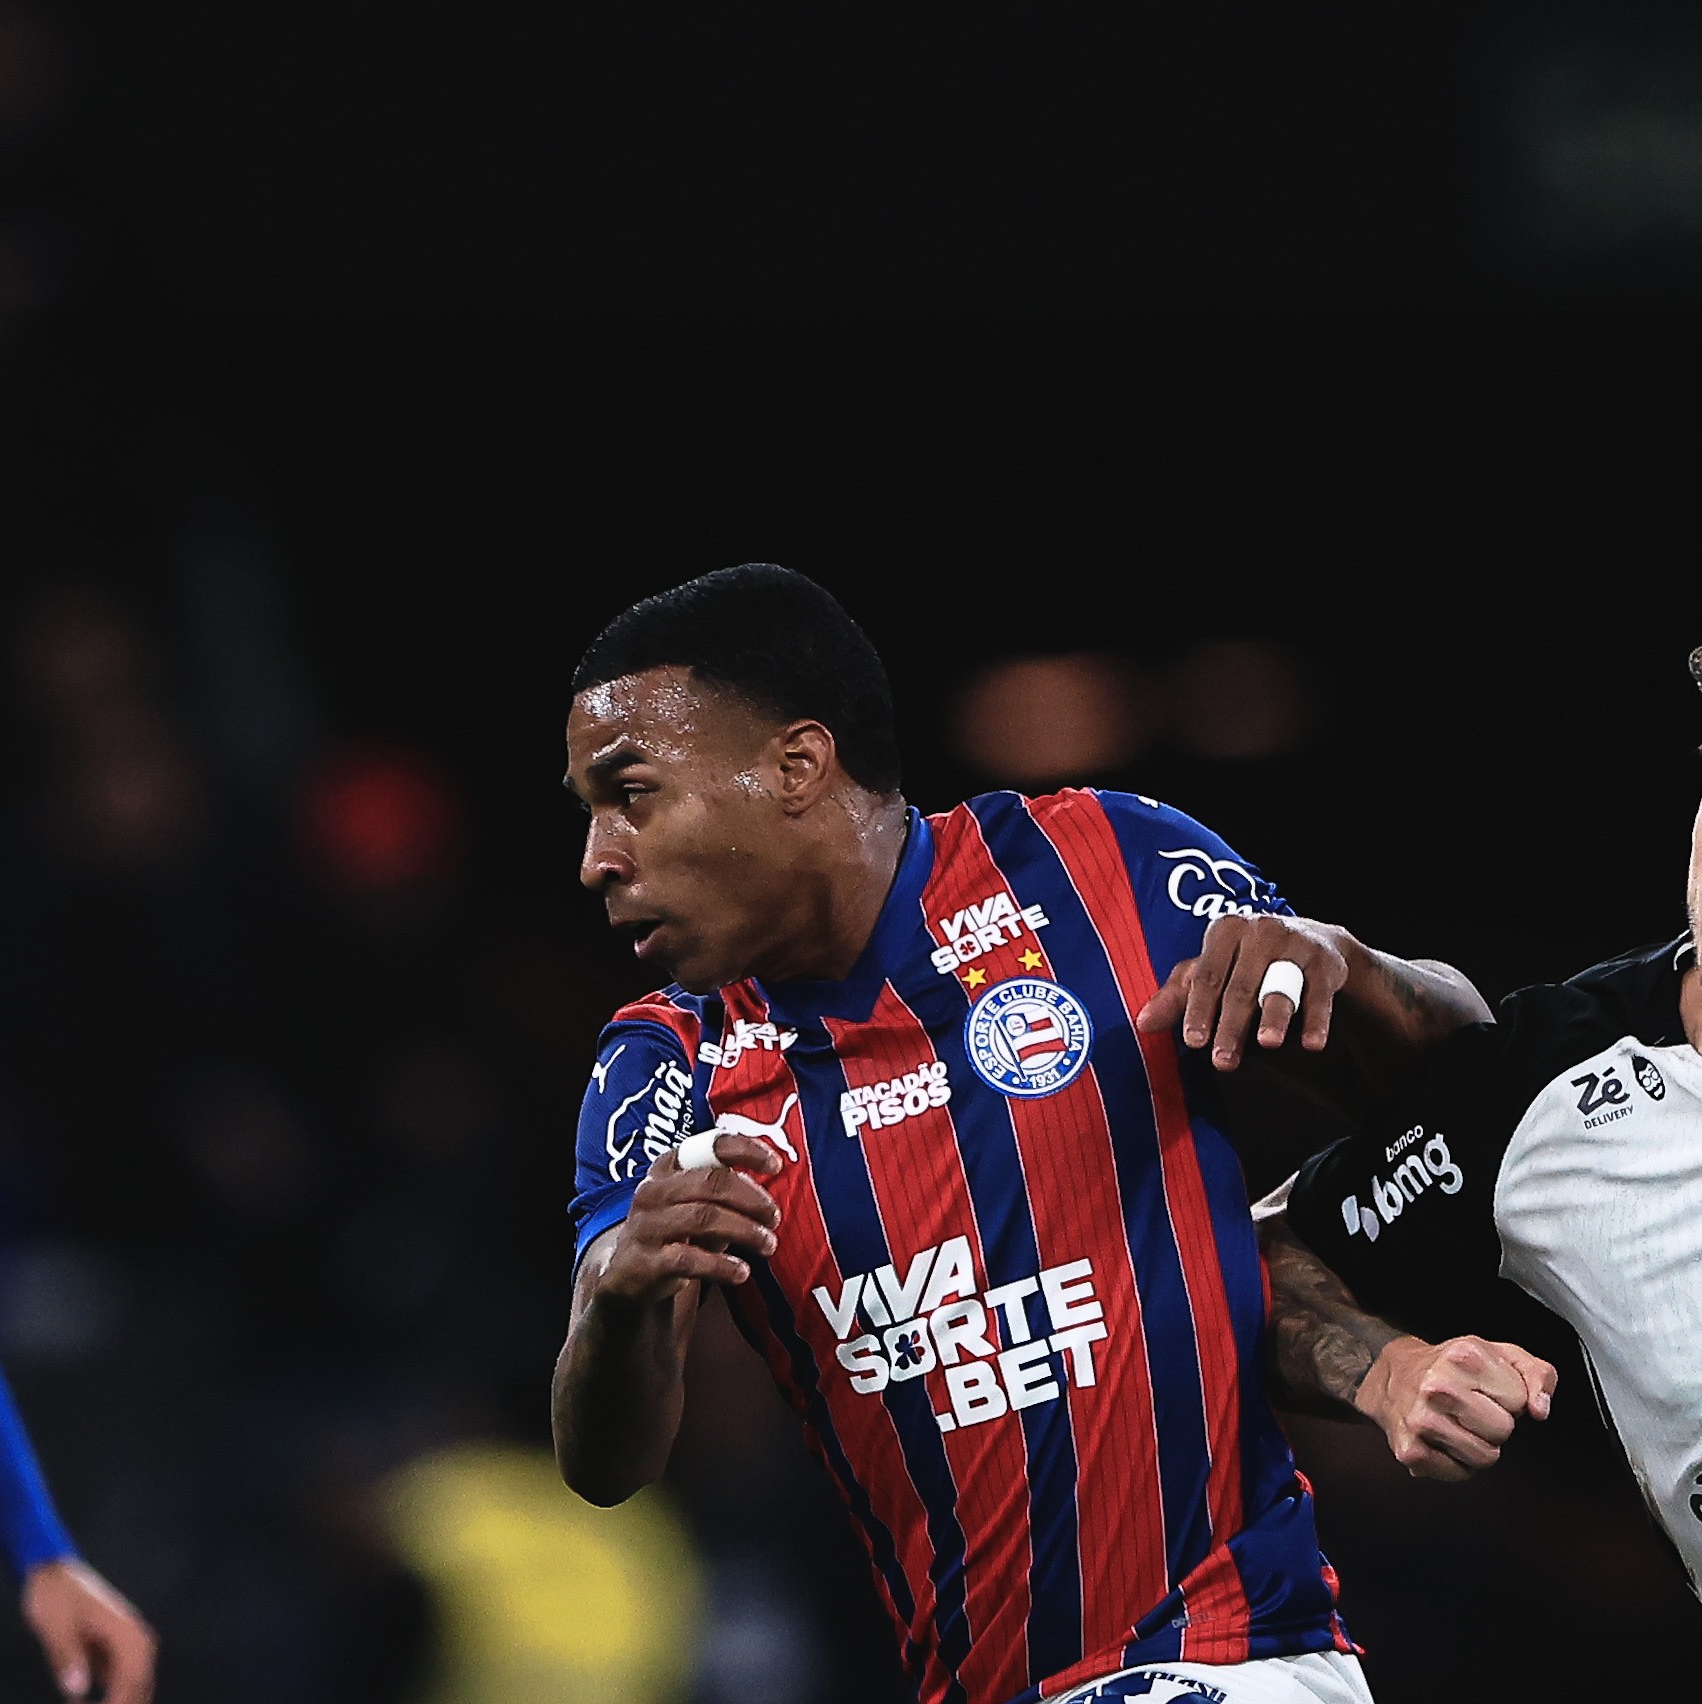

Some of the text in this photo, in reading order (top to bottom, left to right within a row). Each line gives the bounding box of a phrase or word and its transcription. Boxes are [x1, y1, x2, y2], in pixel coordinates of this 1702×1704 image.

[930, 903, 1050, 975] SORTE
[939, 891, 1016, 943] VIVA
[976, 985, 1085, 1080] ESPORTE CLUBE BAHIA
[840, 1061, 947, 1112] ATACADÃO
[841, 1077, 952, 1138] PISOS
[1028, 1068, 1062, 1089] 1931
[1570, 1066, 1631, 1117] Zé
[1385, 1125, 1424, 1163] banco
[1583, 1105, 1634, 1130] DELIVERY
[1371, 1133, 1464, 1225] bmg
[811, 1234, 977, 1340] VIVA
[835, 1257, 1104, 1395] SORTE
[934, 1320, 1109, 1434] .BET
